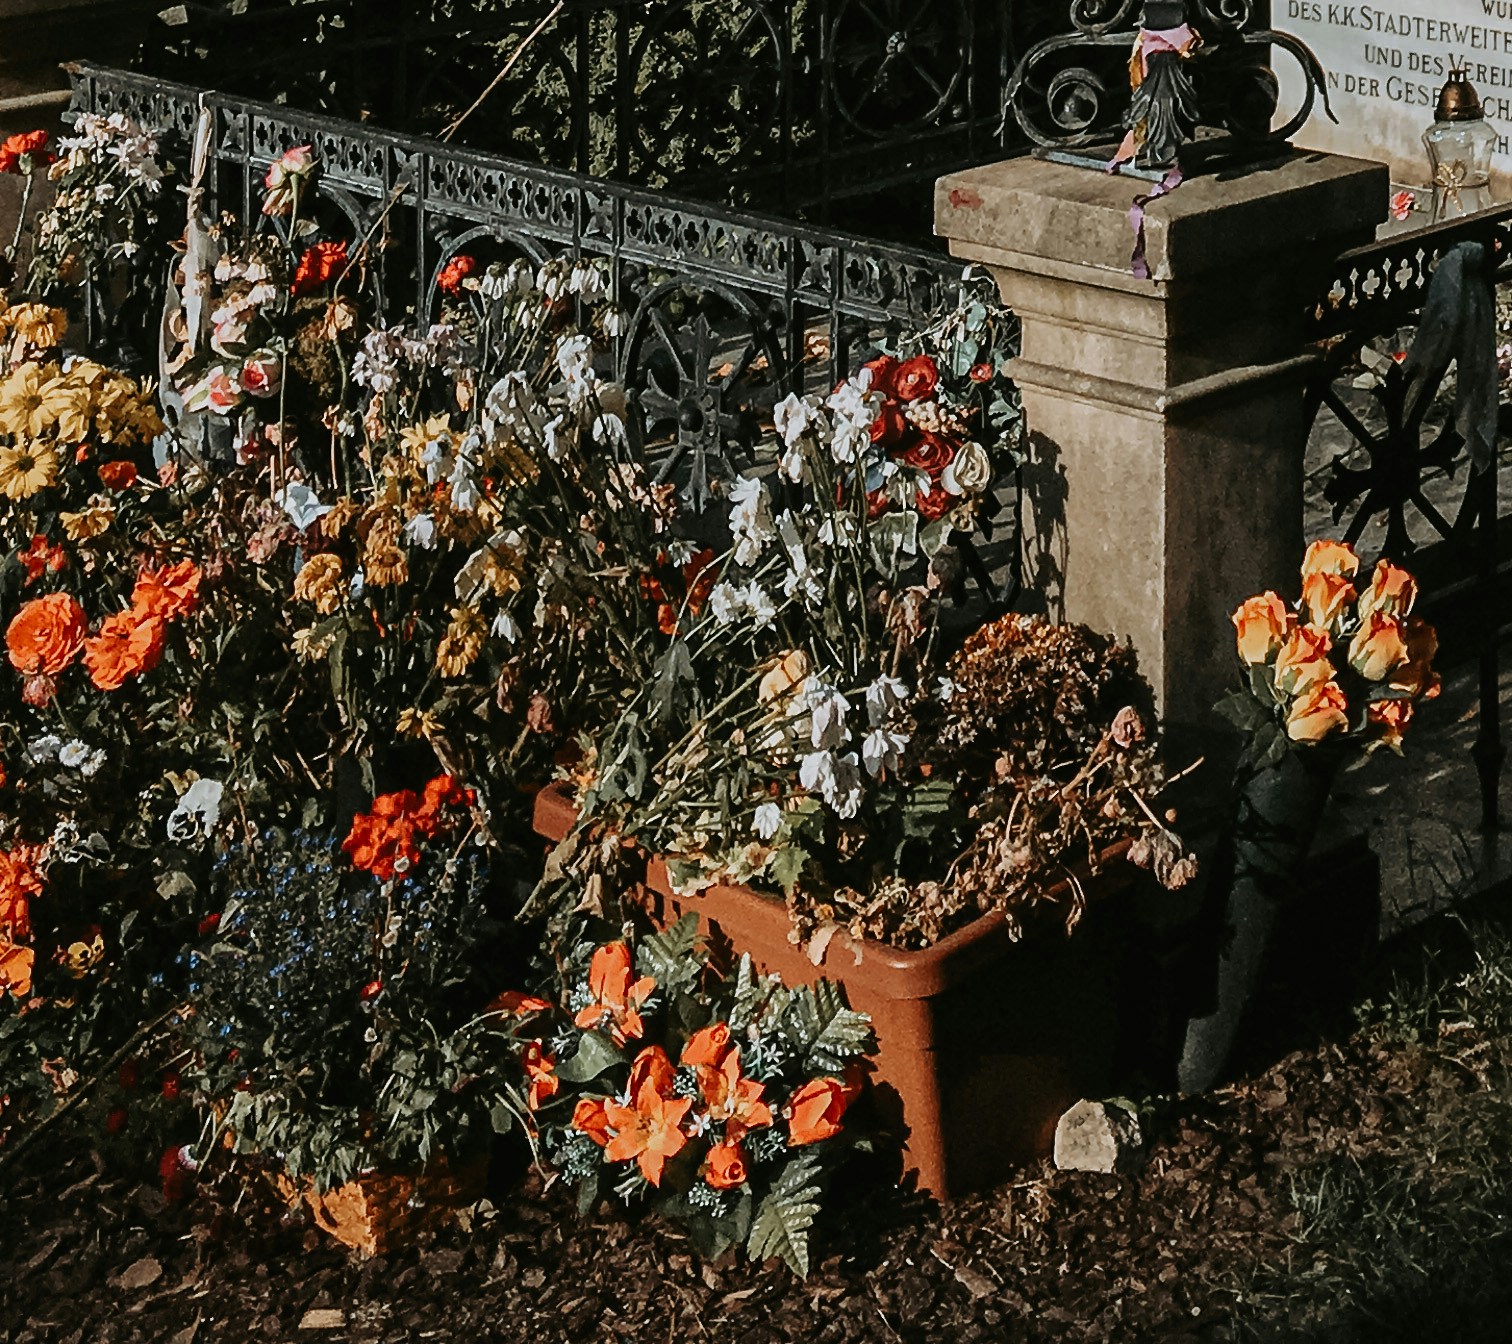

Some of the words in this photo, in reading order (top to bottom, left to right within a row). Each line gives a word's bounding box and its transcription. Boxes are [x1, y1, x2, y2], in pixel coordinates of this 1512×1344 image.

[1288, 0, 1321, 22] DES
[1364, 44, 1402, 68] UND
[1408, 51, 1443, 77] DES
[1345, 74, 1379, 97] DER
